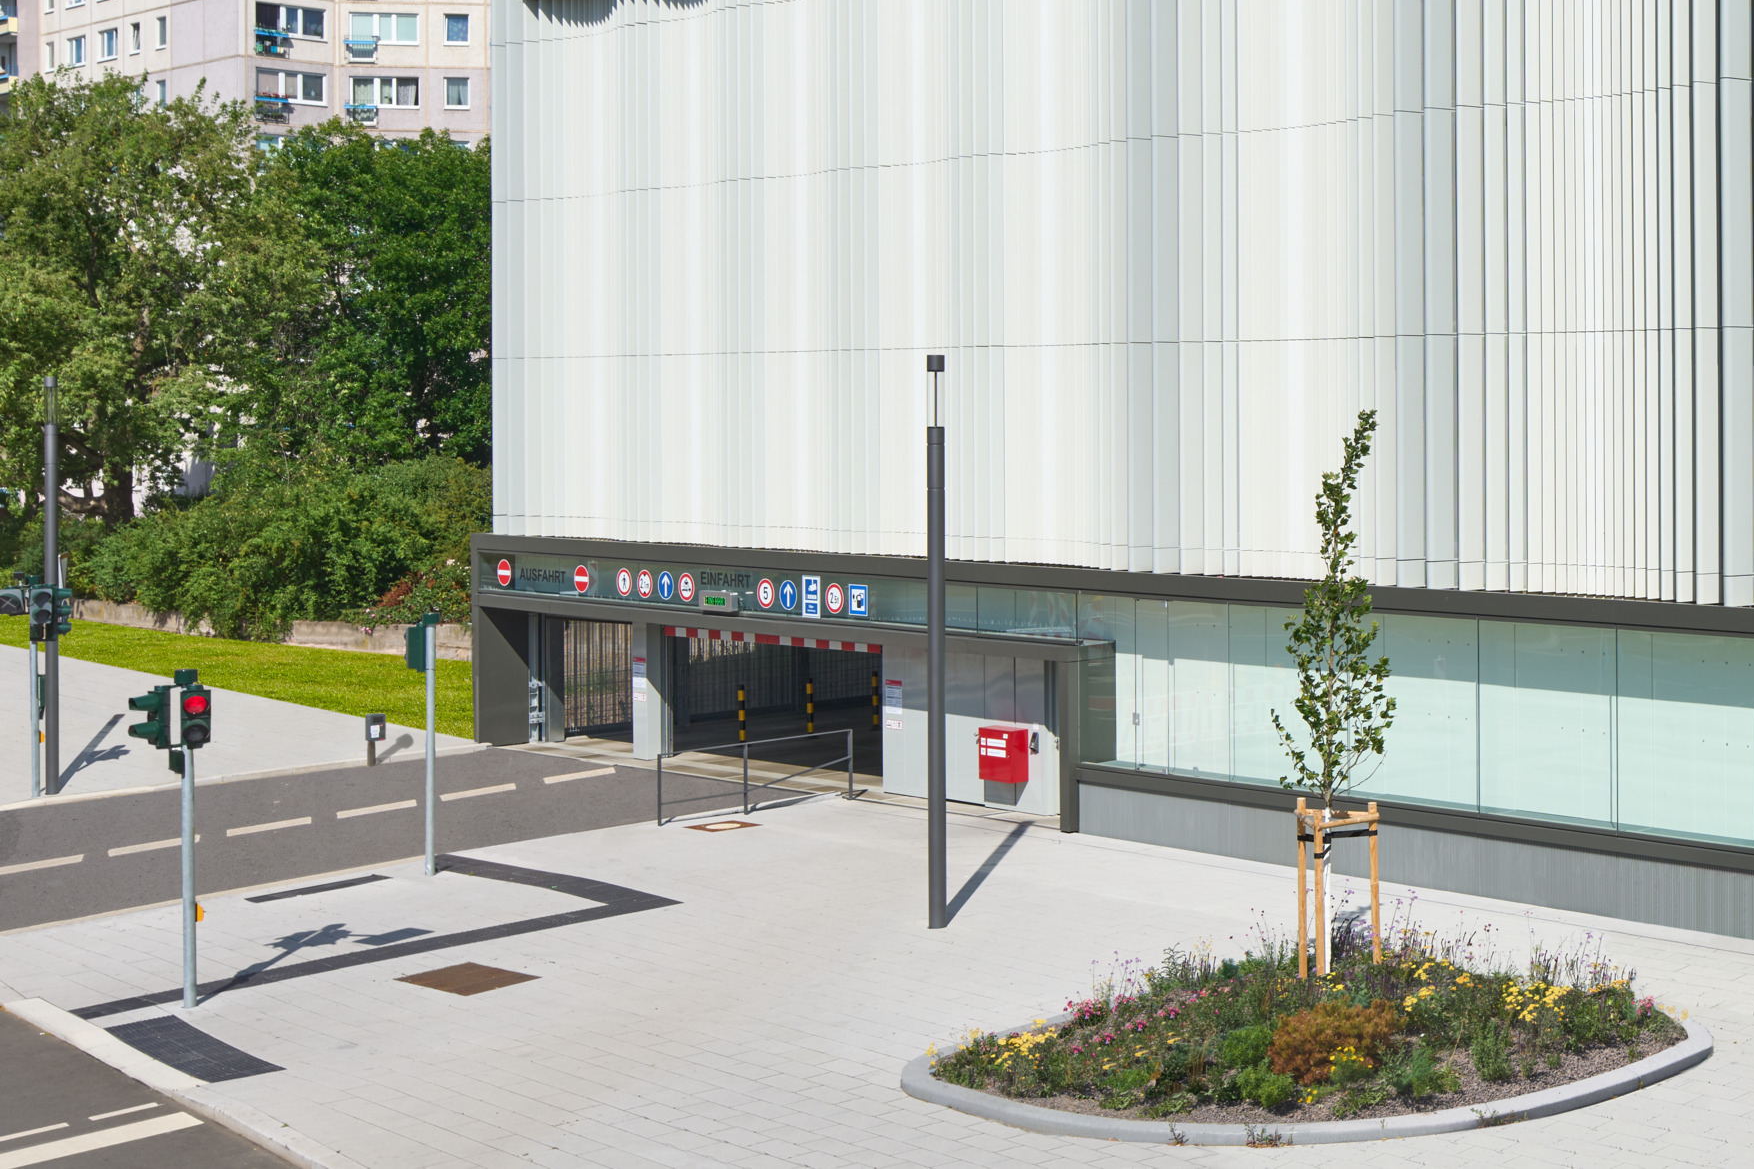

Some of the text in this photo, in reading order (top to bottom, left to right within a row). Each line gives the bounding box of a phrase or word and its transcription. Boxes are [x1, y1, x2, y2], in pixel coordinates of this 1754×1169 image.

[520, 568, 566, 584] AUSFAHRT
[700, 571, 751, 588] EINFAHRT
[763, 586, 769, 600] 5
